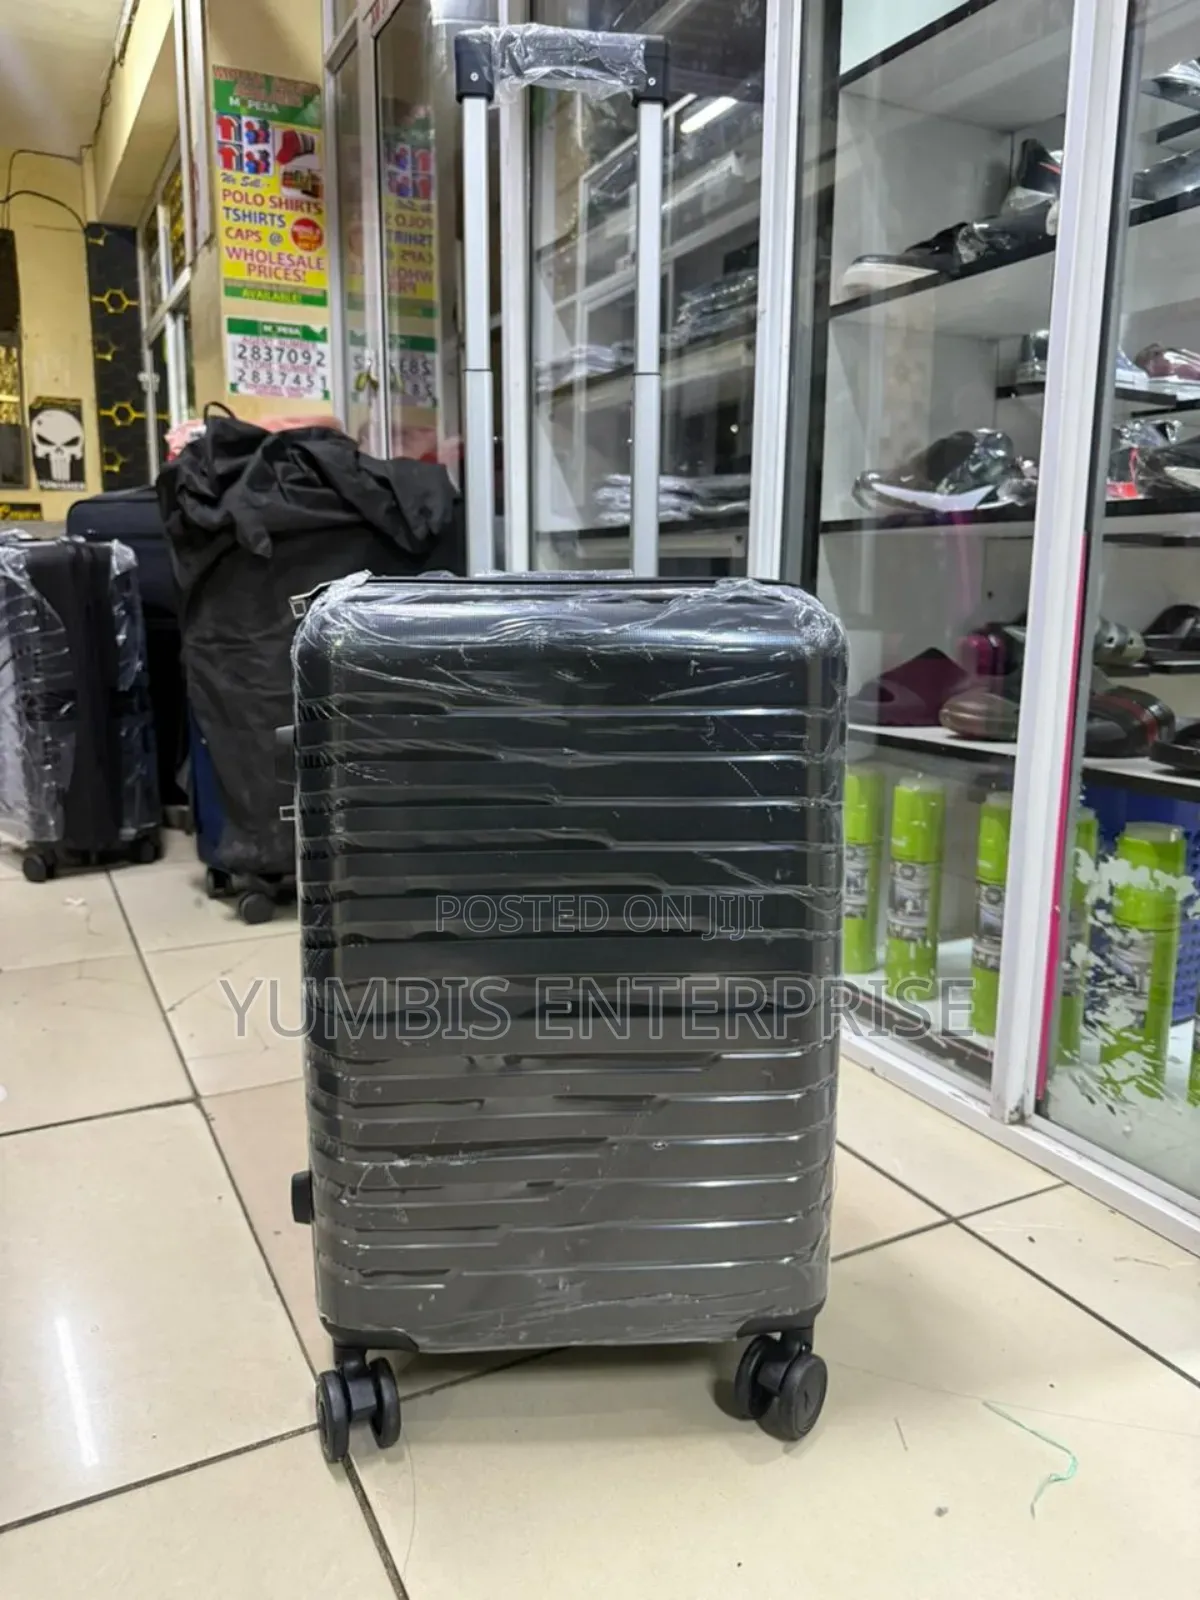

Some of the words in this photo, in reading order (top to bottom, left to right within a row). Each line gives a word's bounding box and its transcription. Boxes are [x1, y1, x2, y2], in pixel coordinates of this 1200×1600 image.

[222, 188, 265, 206] POLO
[269, 195, 323, 215] SHIRTS
[222, 206, 286, 228] TSHIRTS
[225, 226, 262, 242] CAPS
[269, 231, 283, 246] @
[225, 246, 324, 271] WHOLESALE
[248, 263, 307, 282] PRICES!
[238, 344, 326, 367] 2837092
[238, 368, 327, 389] 2837451
